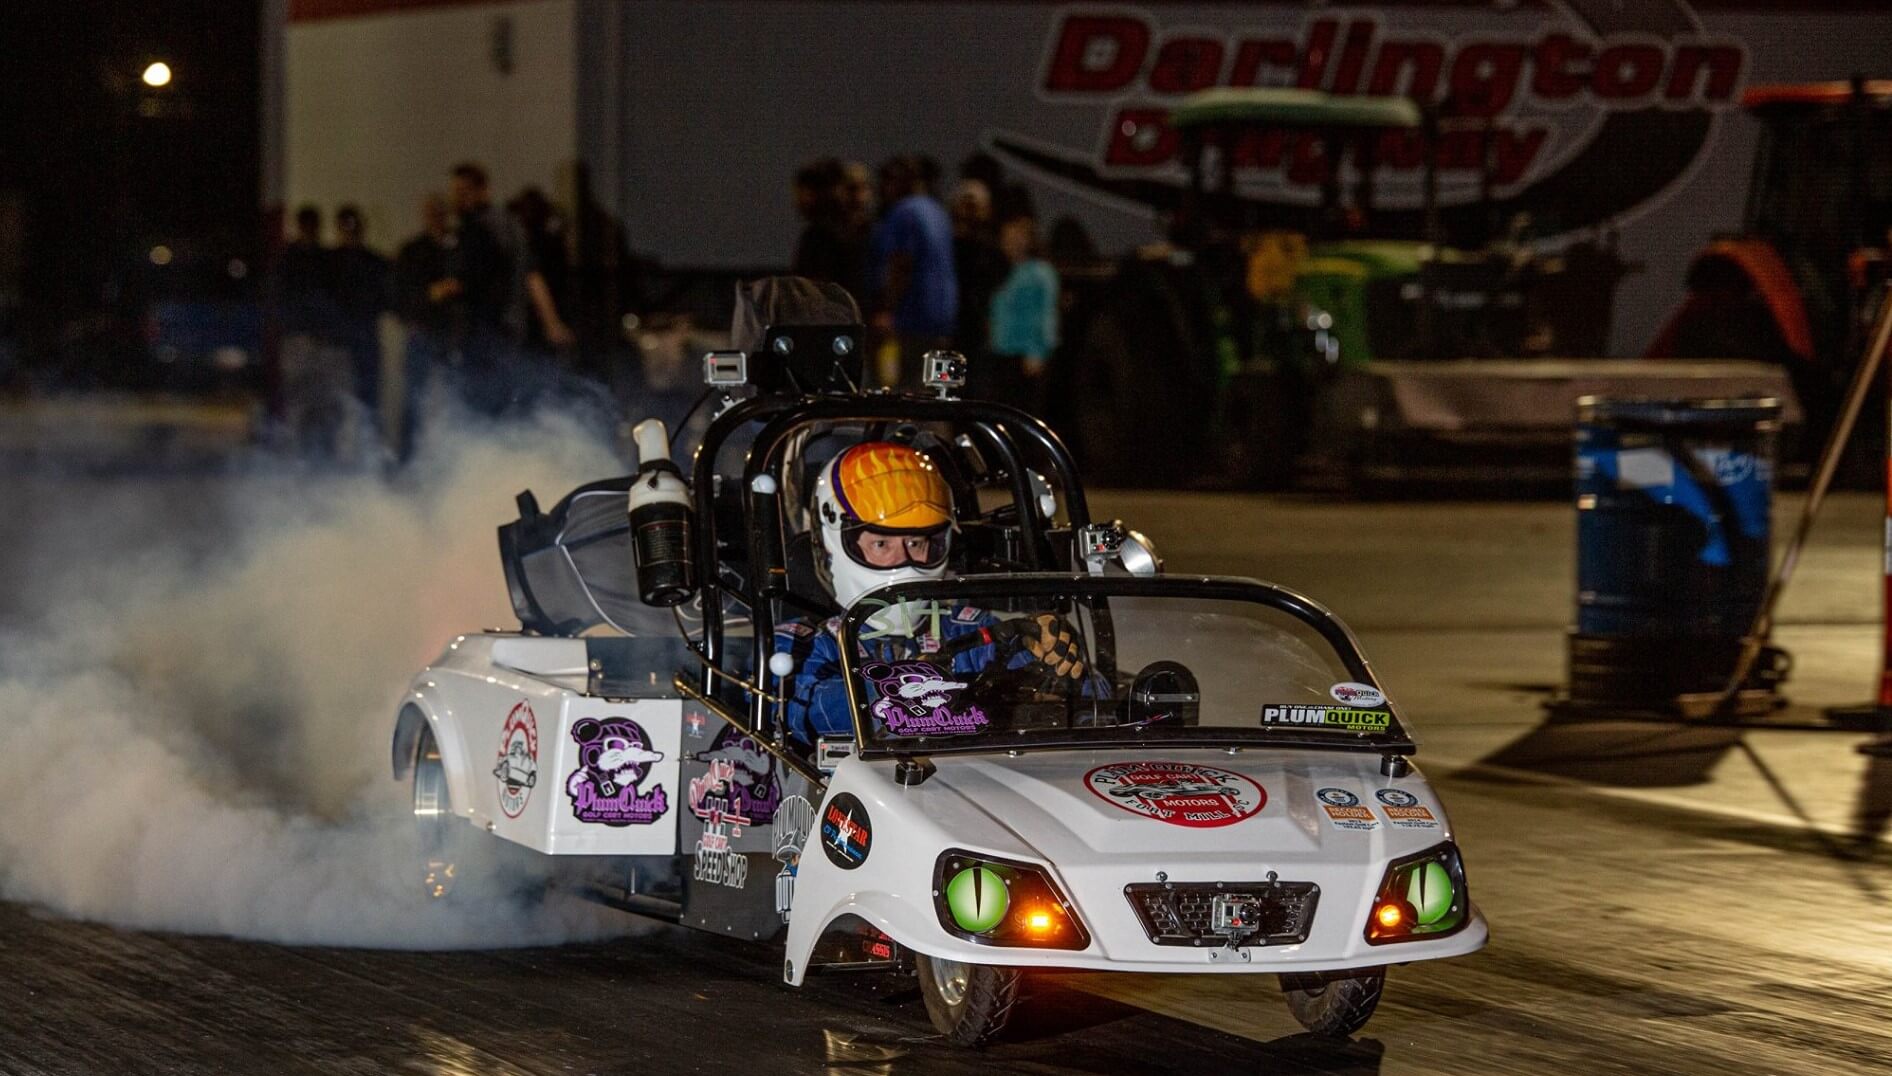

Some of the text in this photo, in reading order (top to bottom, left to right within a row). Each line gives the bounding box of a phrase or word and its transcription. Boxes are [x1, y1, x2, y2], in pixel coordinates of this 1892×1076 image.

[1044, 12, 1747, 117] Darlington
[1263, 707, 1387, 725] PLUM QUICK
[1346, 724, 1387, 732] MOTORS
[1131, 772, 1200, 781] GOLF CART
[1163, 799, 1221, 808] MOTORS
[1183, 809, 1232, 822] MILL
[694, 839, 748, 890] SPEED SHOP
